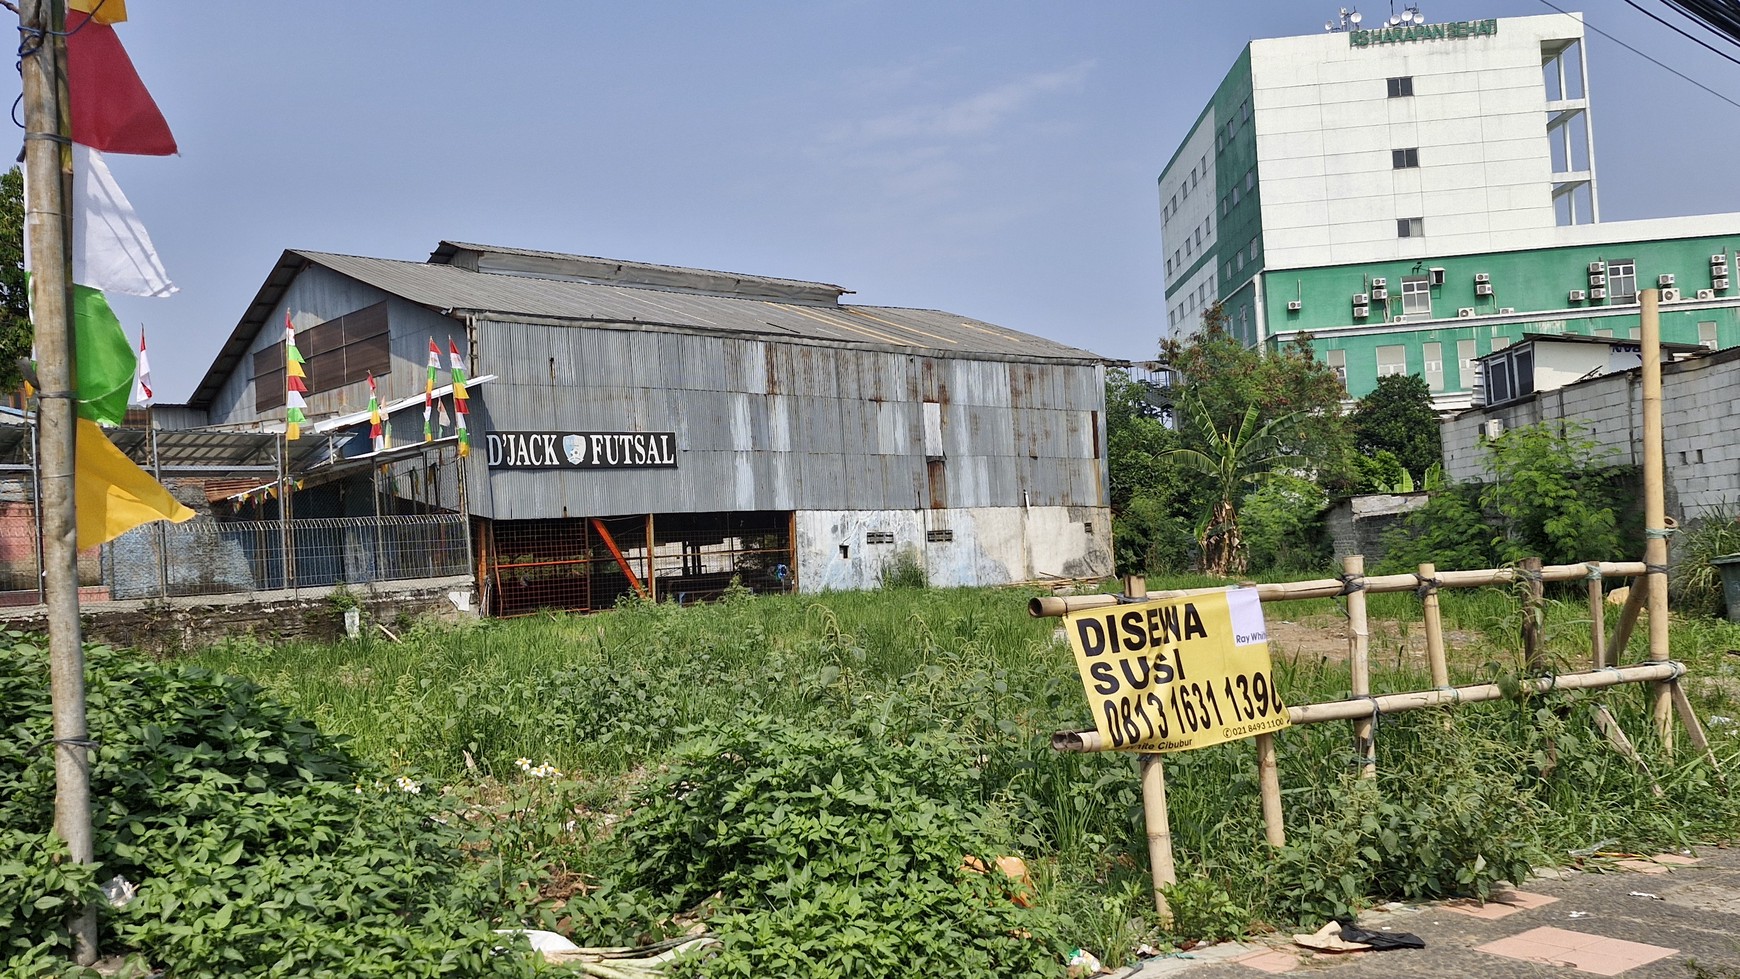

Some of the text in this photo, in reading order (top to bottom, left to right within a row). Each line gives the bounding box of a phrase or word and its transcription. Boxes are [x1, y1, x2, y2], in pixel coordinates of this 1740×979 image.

[1350, 30, 1369, 47] RS
[1371, 23, 1444, 44] HARAPAN
[487, 434, 675, 466] D'JACK FUTSAL
[1076, 602, 1208, 657] DISEWA
[1236, 634, 1250, 644] Ray
[1090, 648, 1186, 695] SUSI
[1103, 691, 1169, 748] 0813
[1171, 680, 1223, 734] 1631
[1232, 717, 1284, 736] 021 8493 1100
[1157, 738, 1193, 750] Cibubur
